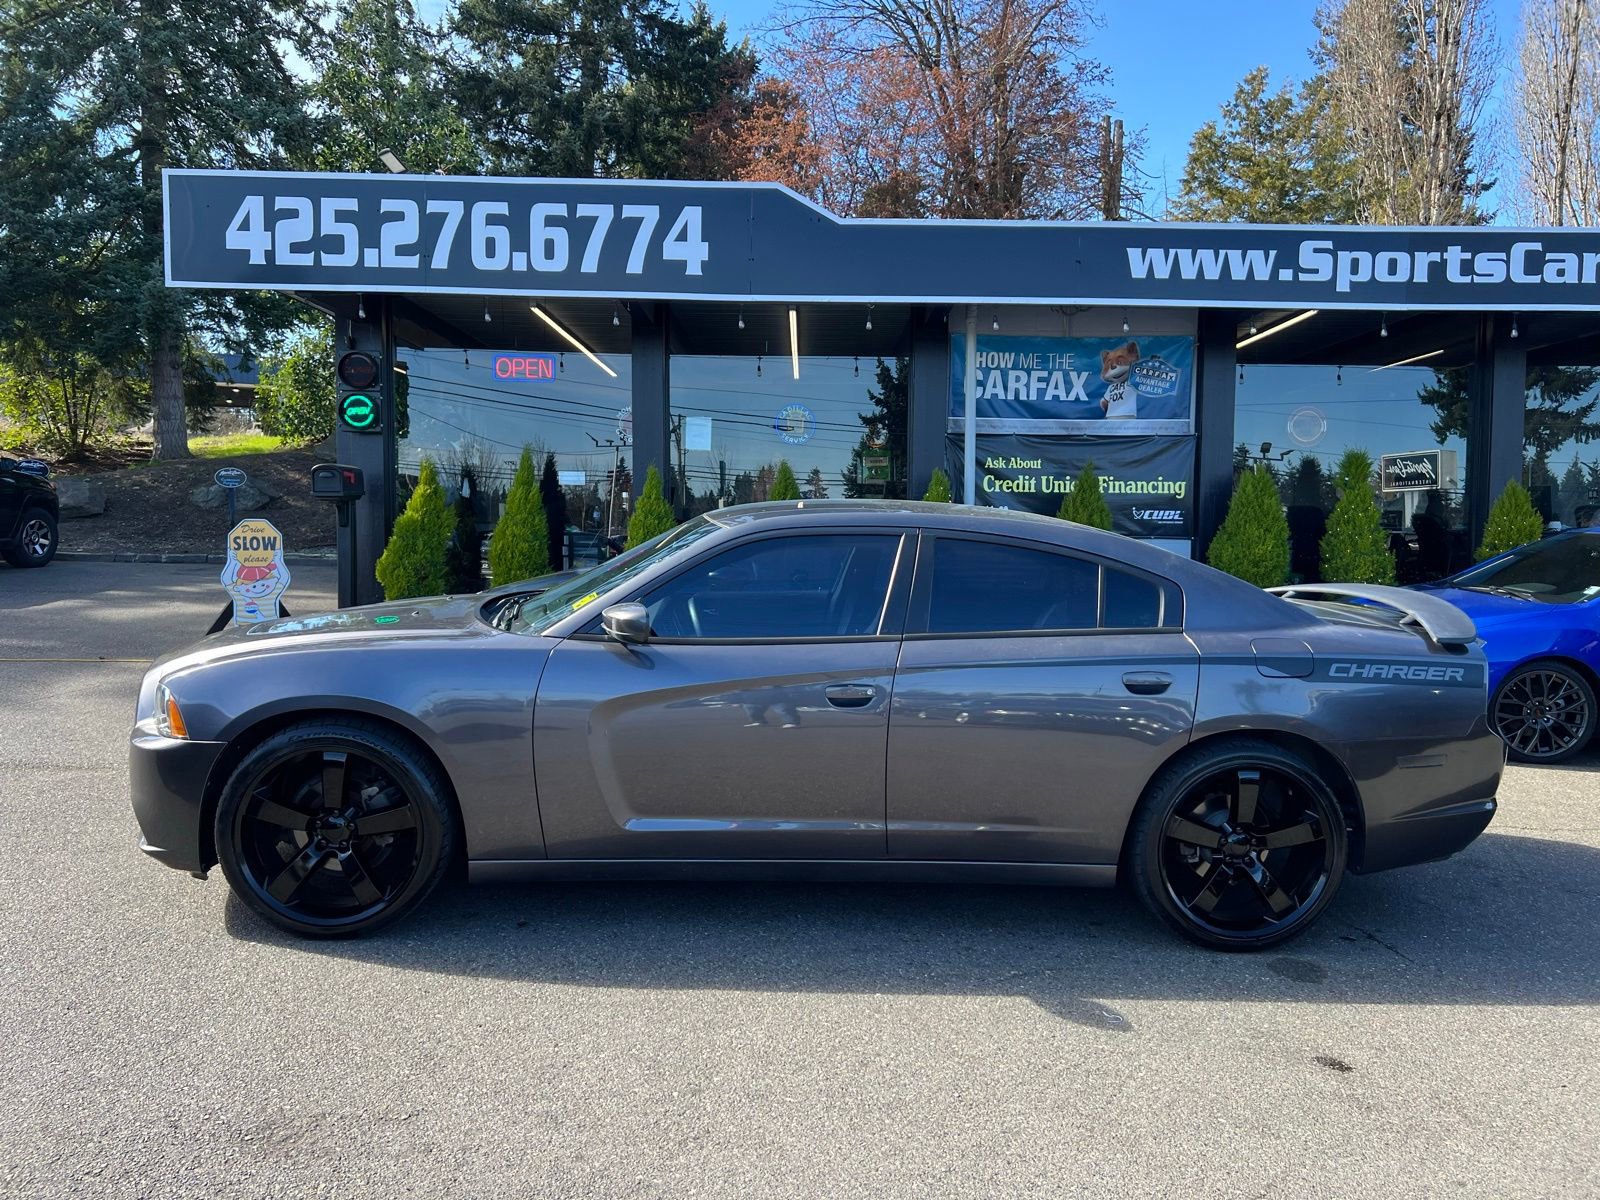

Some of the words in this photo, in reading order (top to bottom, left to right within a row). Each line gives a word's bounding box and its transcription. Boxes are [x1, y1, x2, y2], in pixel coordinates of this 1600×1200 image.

[225, 195, 709, 276] 425.276.6774
[1125, 239, 1600, 293] www.SportsCar
[495, 357, 554, 380] OPEN
[975, 351, 1015, 369] HOW
[1019, 353, 1042, 369] ME
[1046, 353, 1075, 370] THE
[1134, 366, 1177, 381] CARFAX
[1135, 375, 1171, 389] ADVANTAGE
[1138, 384, 1164, 395] DEALER
[781, 432, 810, 444] SERVICE
[984, 457, 1006, 469] Ask
[1008, 457, 1042, 469] About
[983, 475, 1037, 493] Credit
[1041, 475, 1076, 493] Uni
[1098, 476, 1187, 499] Financing
[240, 524, 265, 534] Drive
[232, 535, 278, 552] SLOW
[243, 554, 269, 564] please
[1328, 663, 1465, 682] CHARGER
